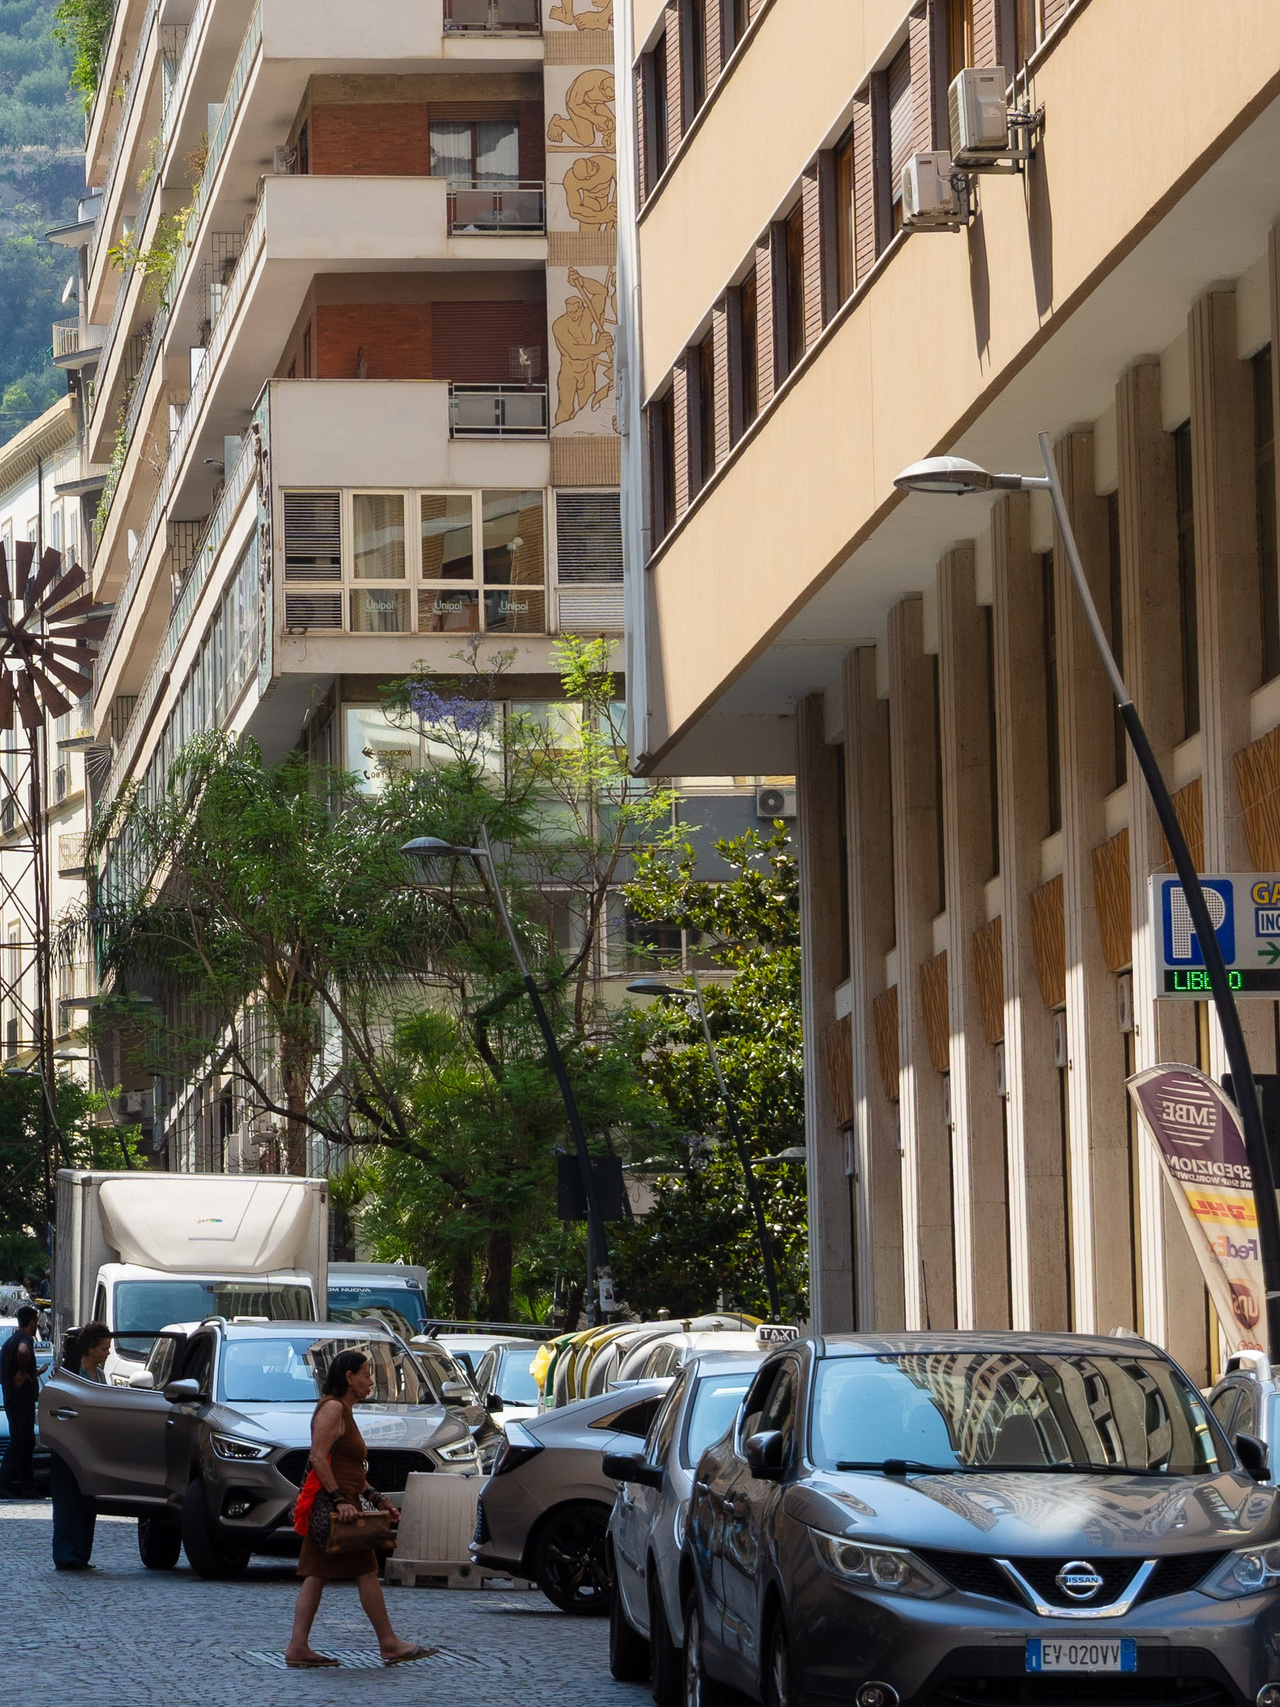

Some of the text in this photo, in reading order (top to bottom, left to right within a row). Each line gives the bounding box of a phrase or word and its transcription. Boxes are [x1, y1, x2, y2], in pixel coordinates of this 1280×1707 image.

[366, 600, 395, 612] Unipol
[434, 600, 463, 612] Unipol
[500, 600, 529, 612] Unipol
[1170, 887, 1226, 958] P
[1174, 971, 1241, 990] LIBEO
[760, 1328, 795, 1341] TAXI
